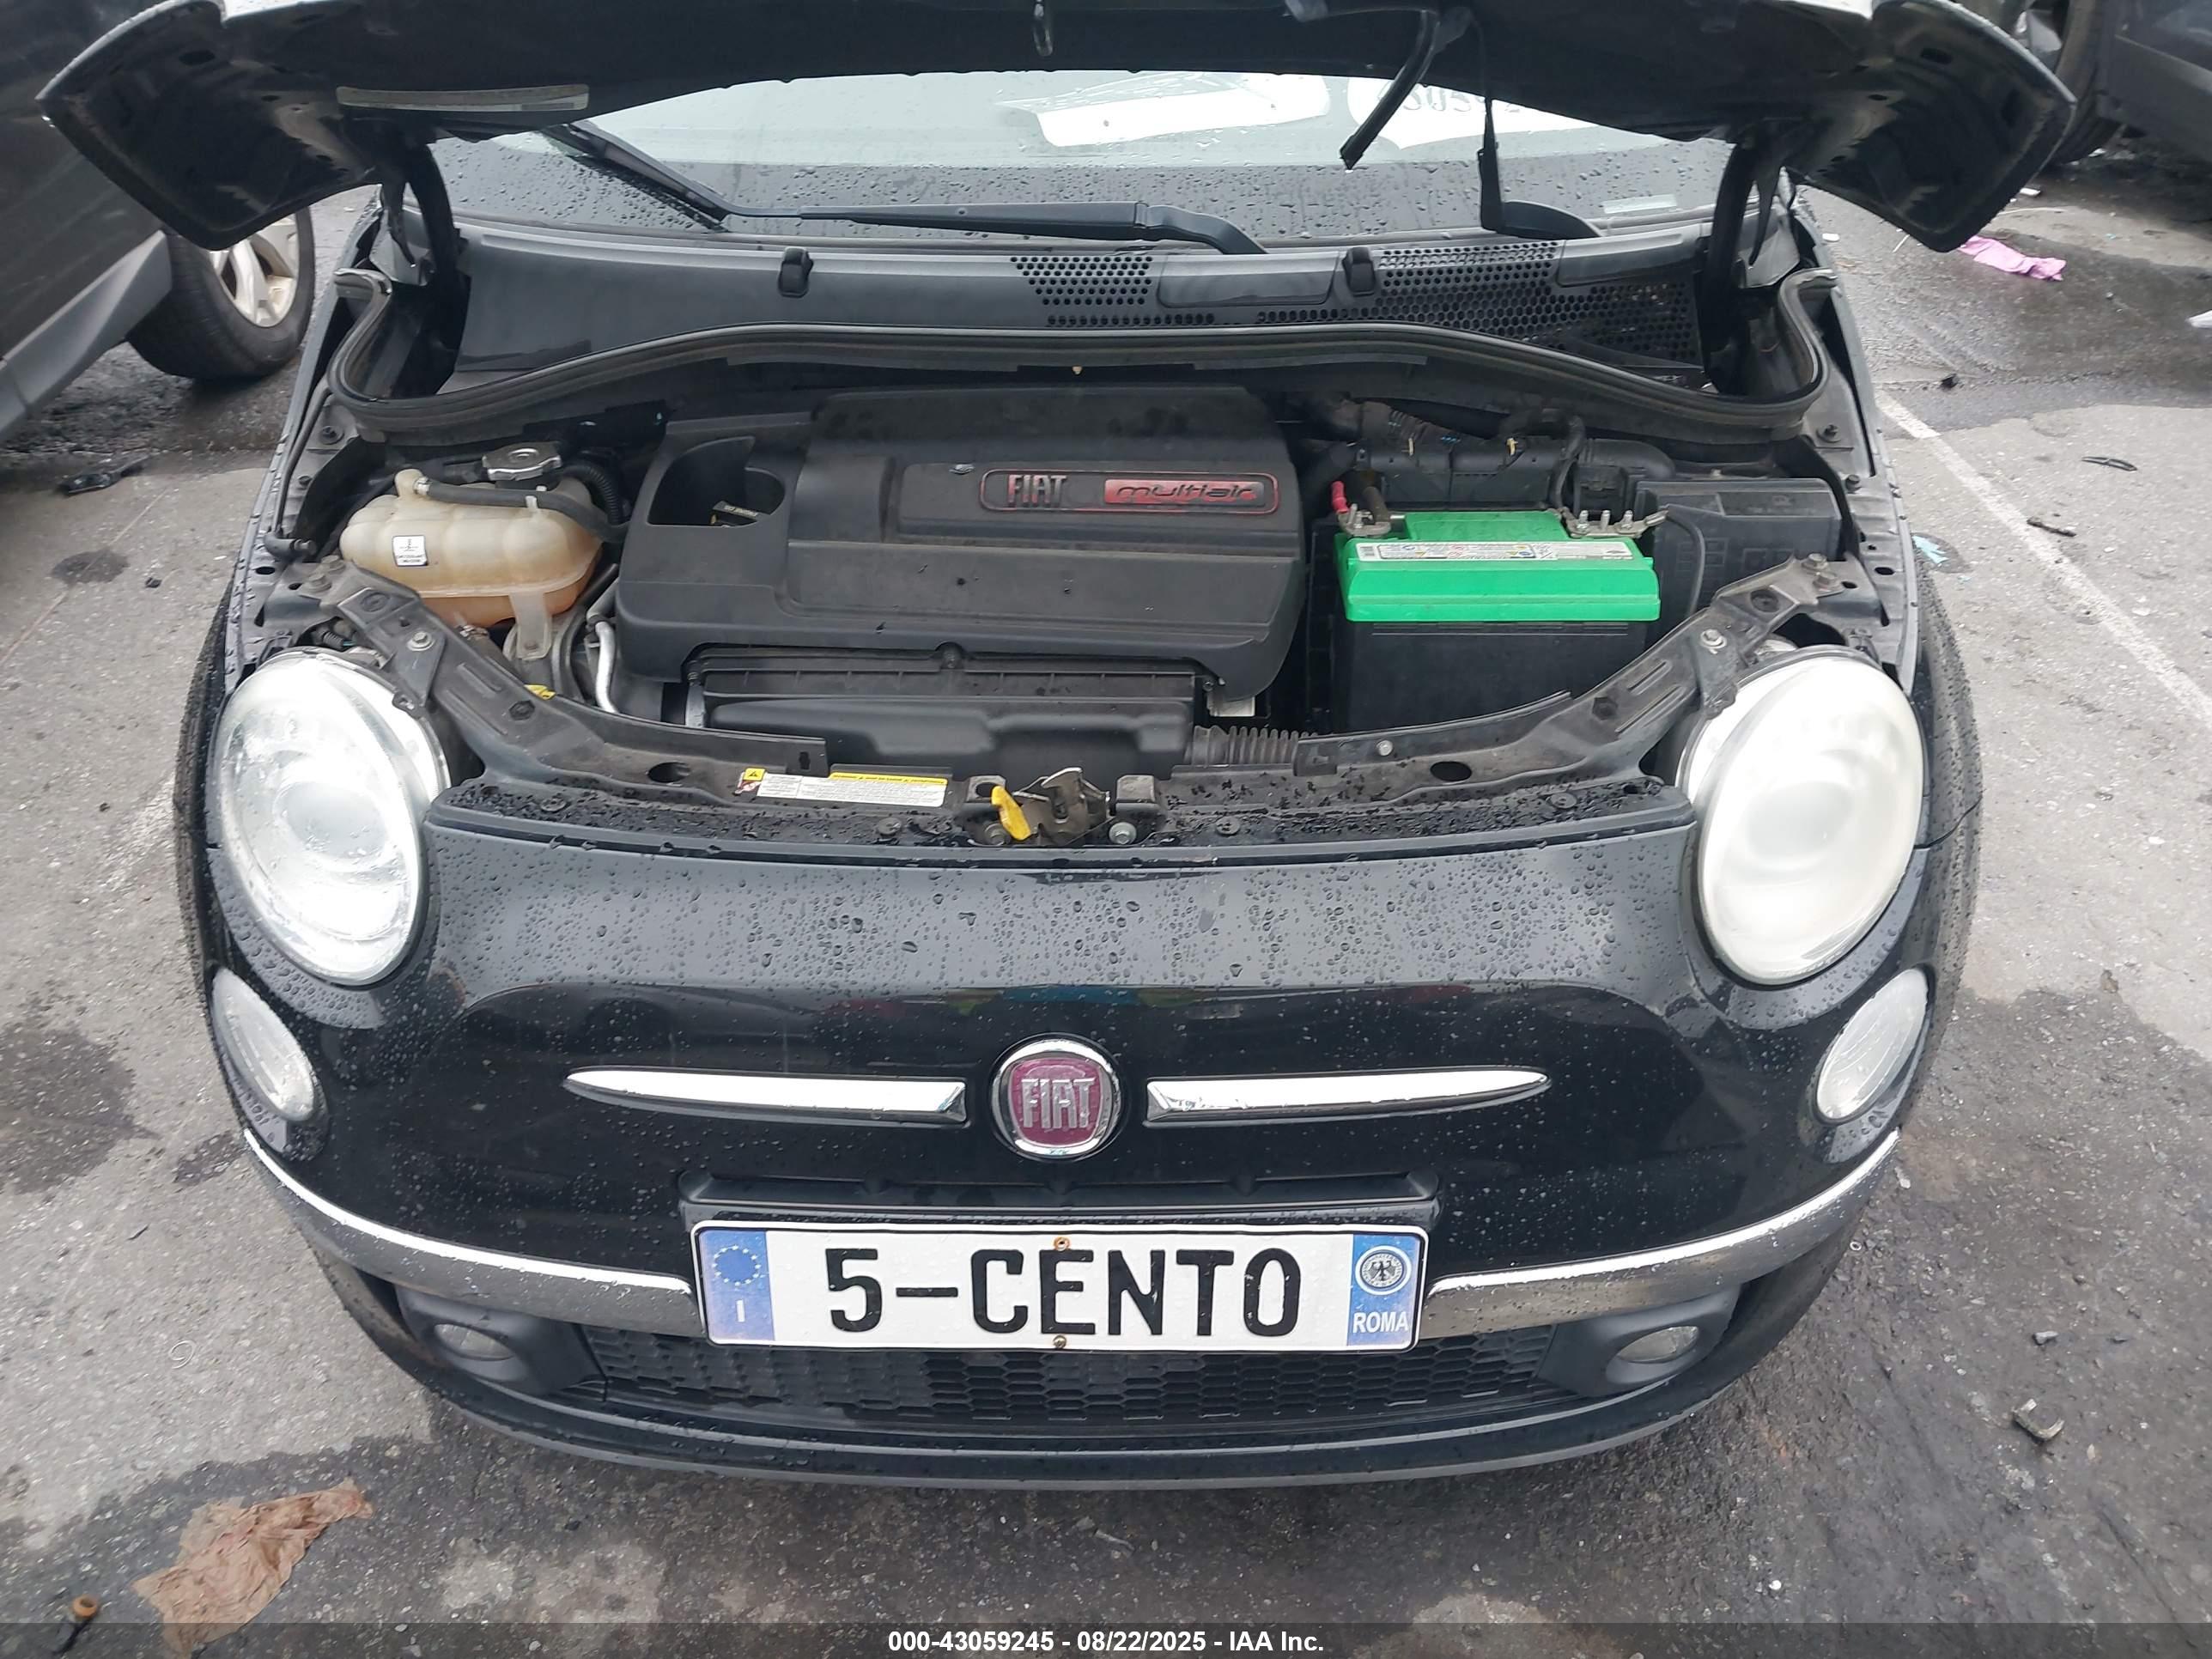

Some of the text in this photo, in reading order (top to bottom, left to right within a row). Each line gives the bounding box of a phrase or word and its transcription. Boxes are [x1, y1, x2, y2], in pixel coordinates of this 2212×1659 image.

[1006, 474, 1067, 507] FIAT
[1115, 483, 1253, 501] multiair
[1021, 1077, 1097, 1129] FIAT
[825, 1248, 1301, 1337] 5-CENTO
[1352, 1310, 1410, 1334] ROMA
